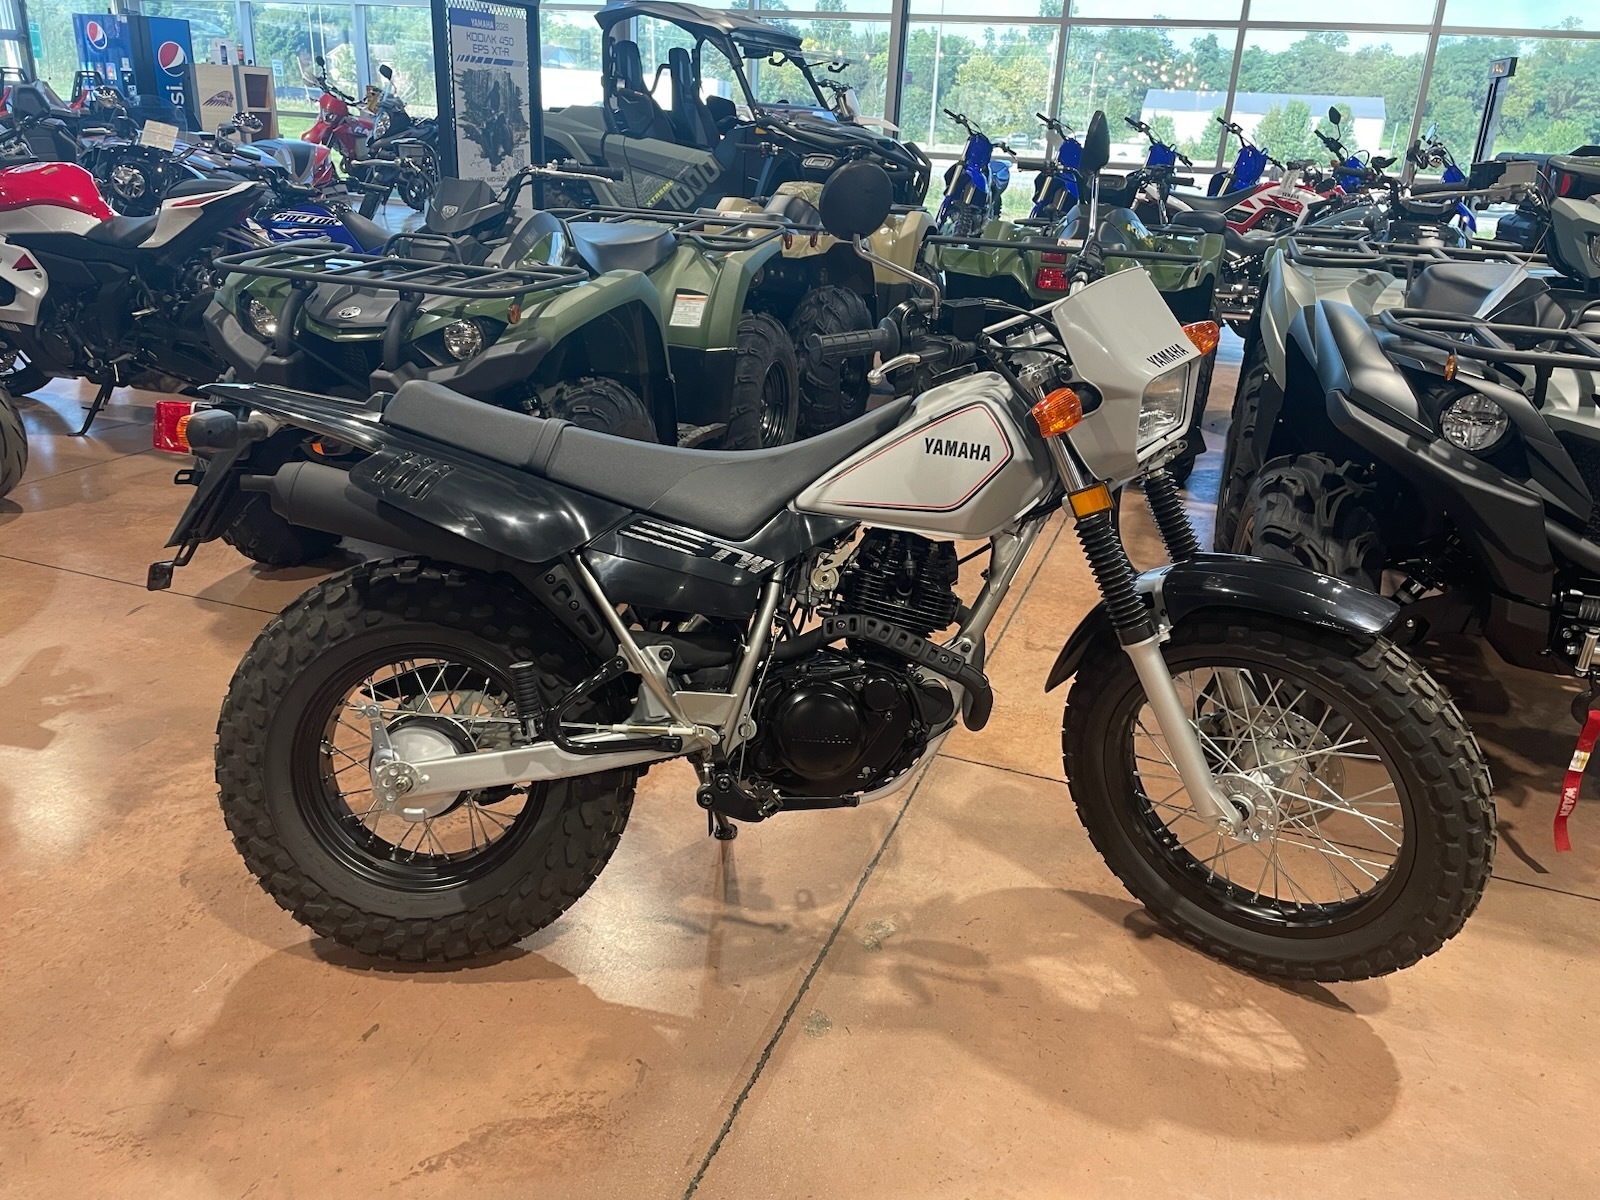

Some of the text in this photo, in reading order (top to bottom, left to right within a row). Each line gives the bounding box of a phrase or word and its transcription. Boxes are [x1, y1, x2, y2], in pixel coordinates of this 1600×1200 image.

[470, 18, 494, 29] YAMAHA
[466, 32, 514, 46] KODIAK 450
[472, 44, 509, 56] EPS XT-R
[664, 157, 720, 210] 1000
[1146, 343, 1189, 368] YAMAHA
[924, 437, 990, 462] YAMAHA
[1559, 787, 1577, 816] WARN
